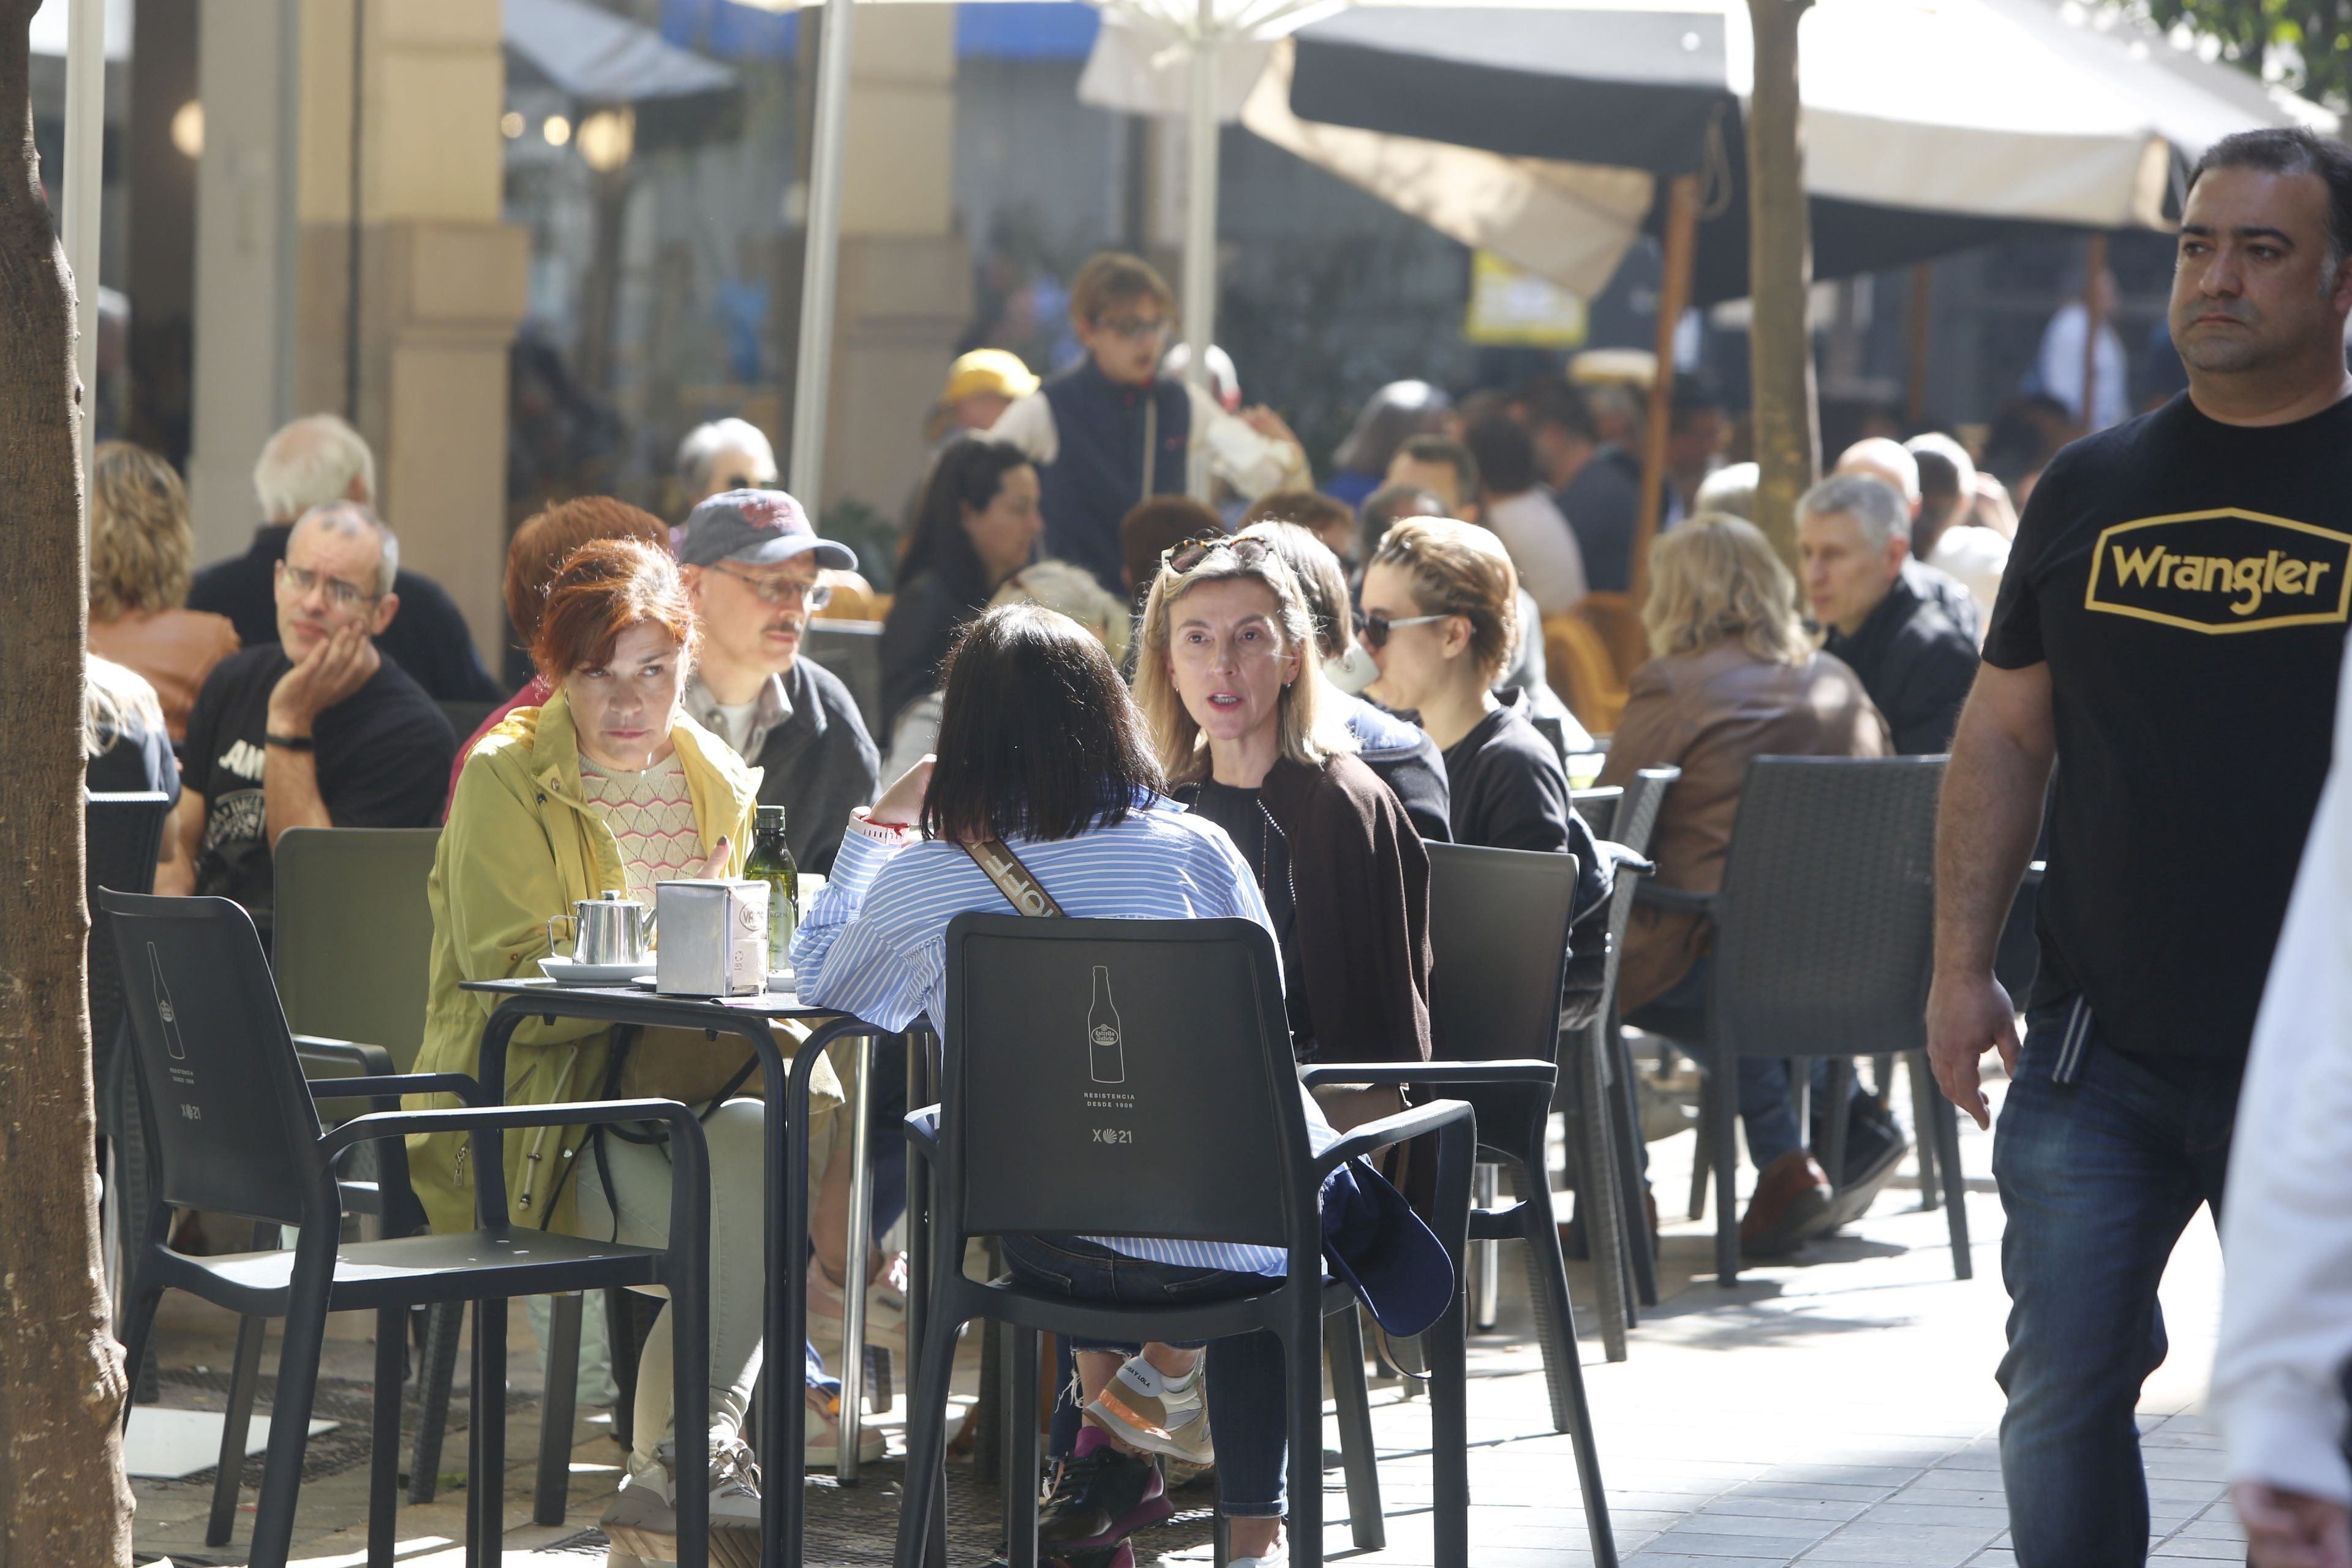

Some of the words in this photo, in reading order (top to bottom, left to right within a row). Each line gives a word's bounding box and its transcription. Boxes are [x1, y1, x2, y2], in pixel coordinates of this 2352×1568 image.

[2111, 545, 2331, 616] Wrangler
[985, 855, 1054, 918] OFF
[1137, 1375, 1150, 1387] LOLA
